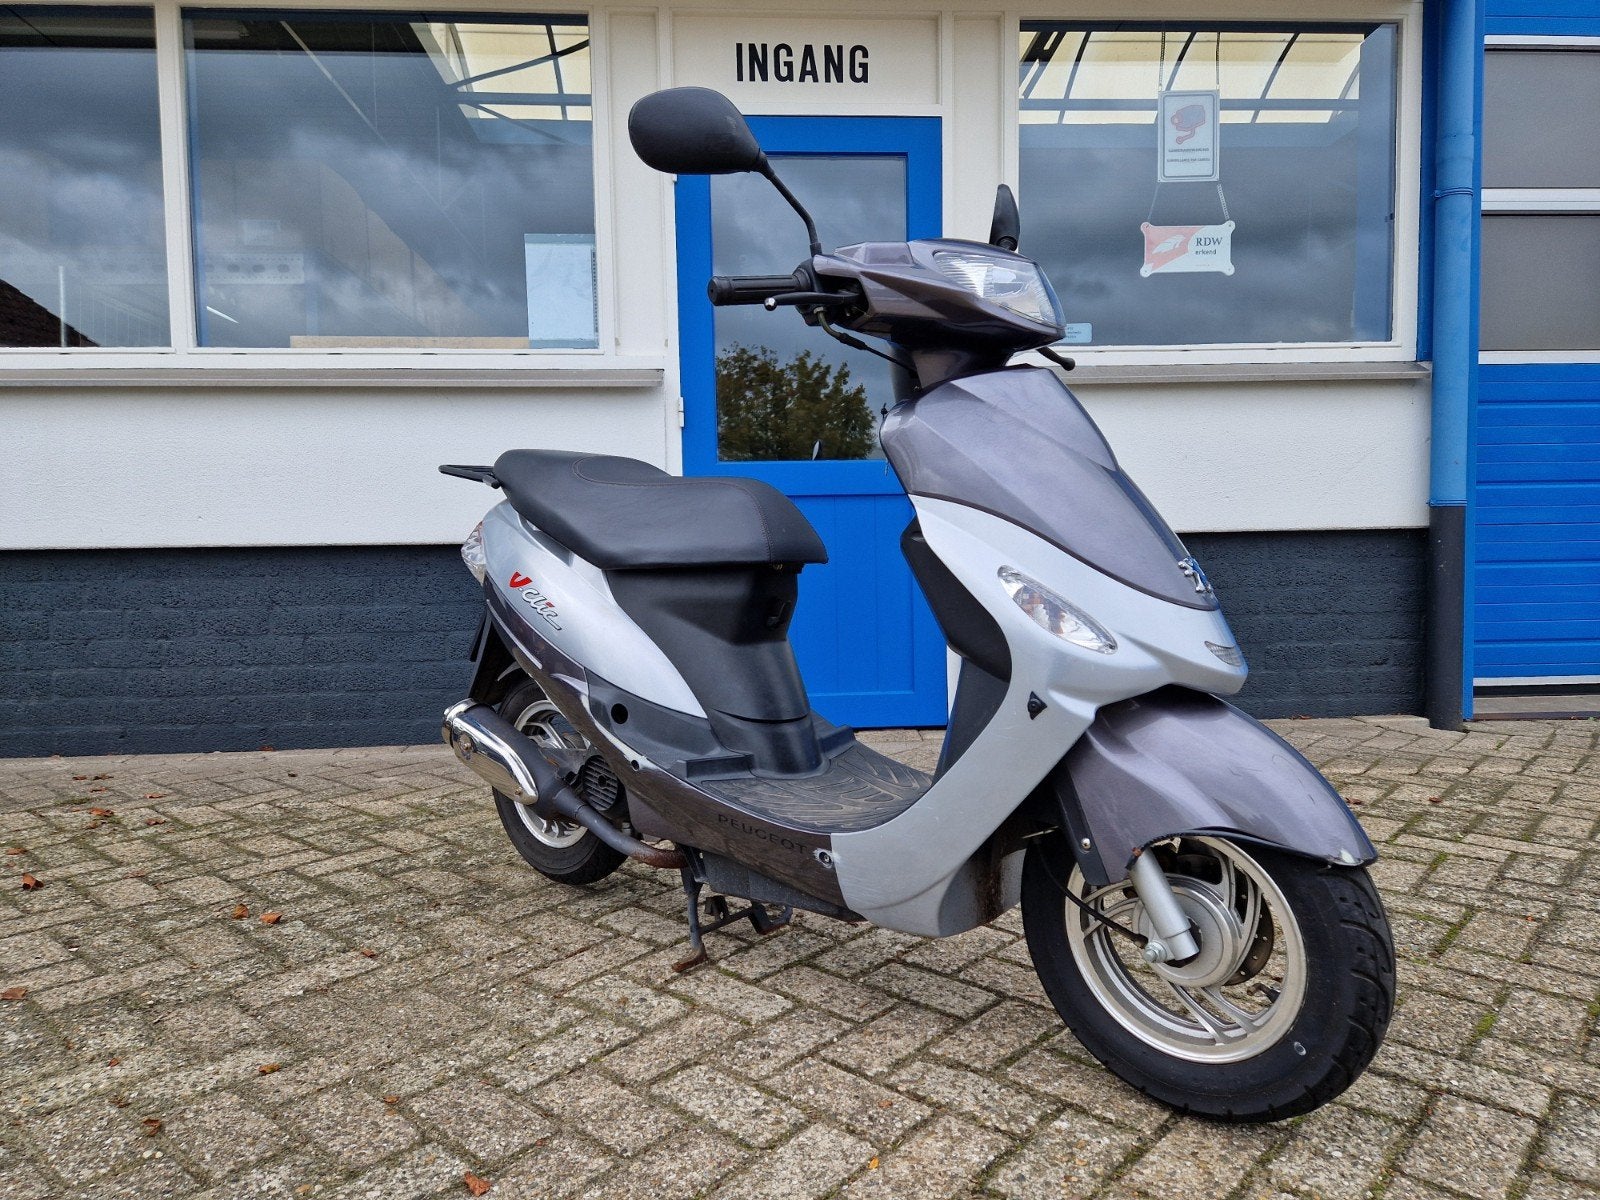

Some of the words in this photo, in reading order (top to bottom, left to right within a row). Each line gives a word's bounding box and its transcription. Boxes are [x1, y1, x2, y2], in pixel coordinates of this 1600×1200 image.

[736, 43, 869, 83] INGANG
[1195, 237, 1223, 247] RDW
[718, 814, 807, 854] PEUGEOT
